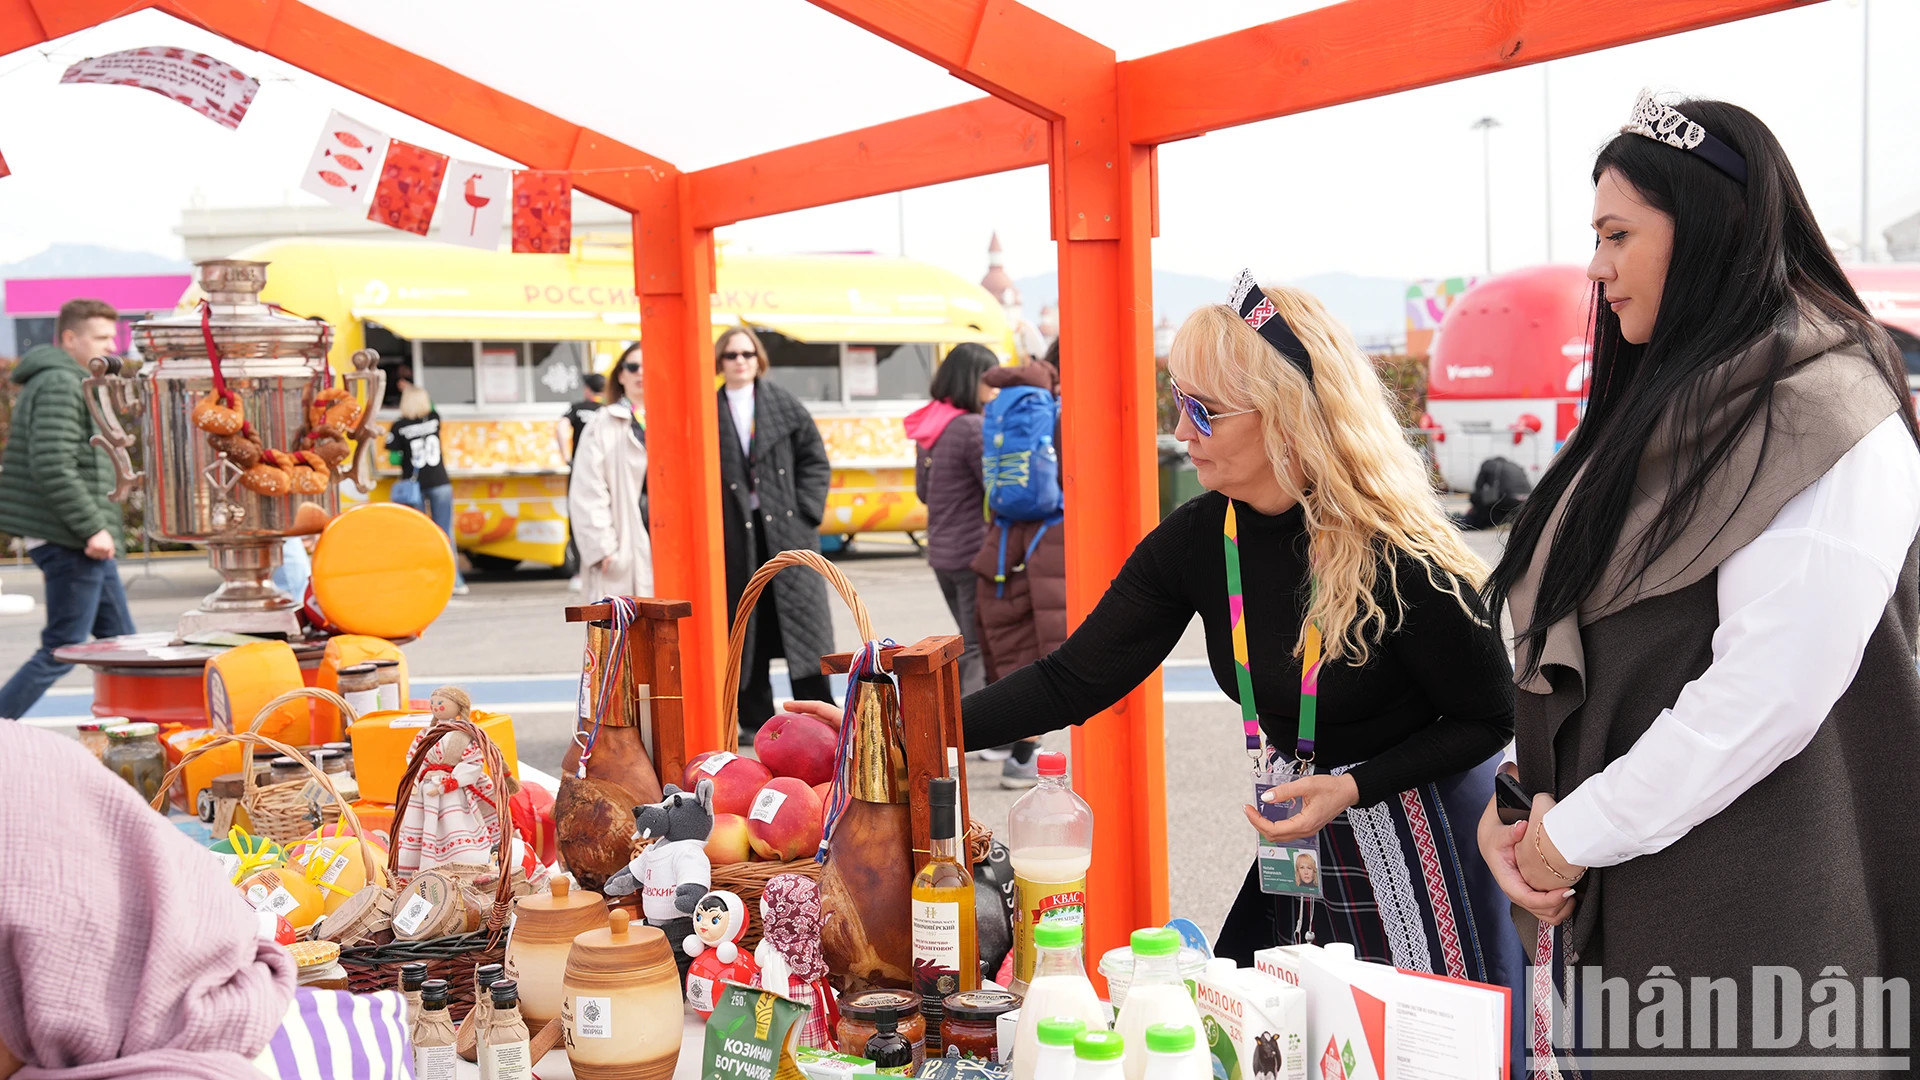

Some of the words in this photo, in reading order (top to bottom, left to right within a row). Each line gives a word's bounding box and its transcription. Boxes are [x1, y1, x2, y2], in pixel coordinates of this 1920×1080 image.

[410, 433, 440, 468] 50
[645, 868, 652, 880] Я
[1052, 891, 1080, 905] КВАС
[731, 995, 744, 1006] 250
[1197, 982, 1243, 1019] МОЛОКО
[920, 1059, 943, 1079] 12
